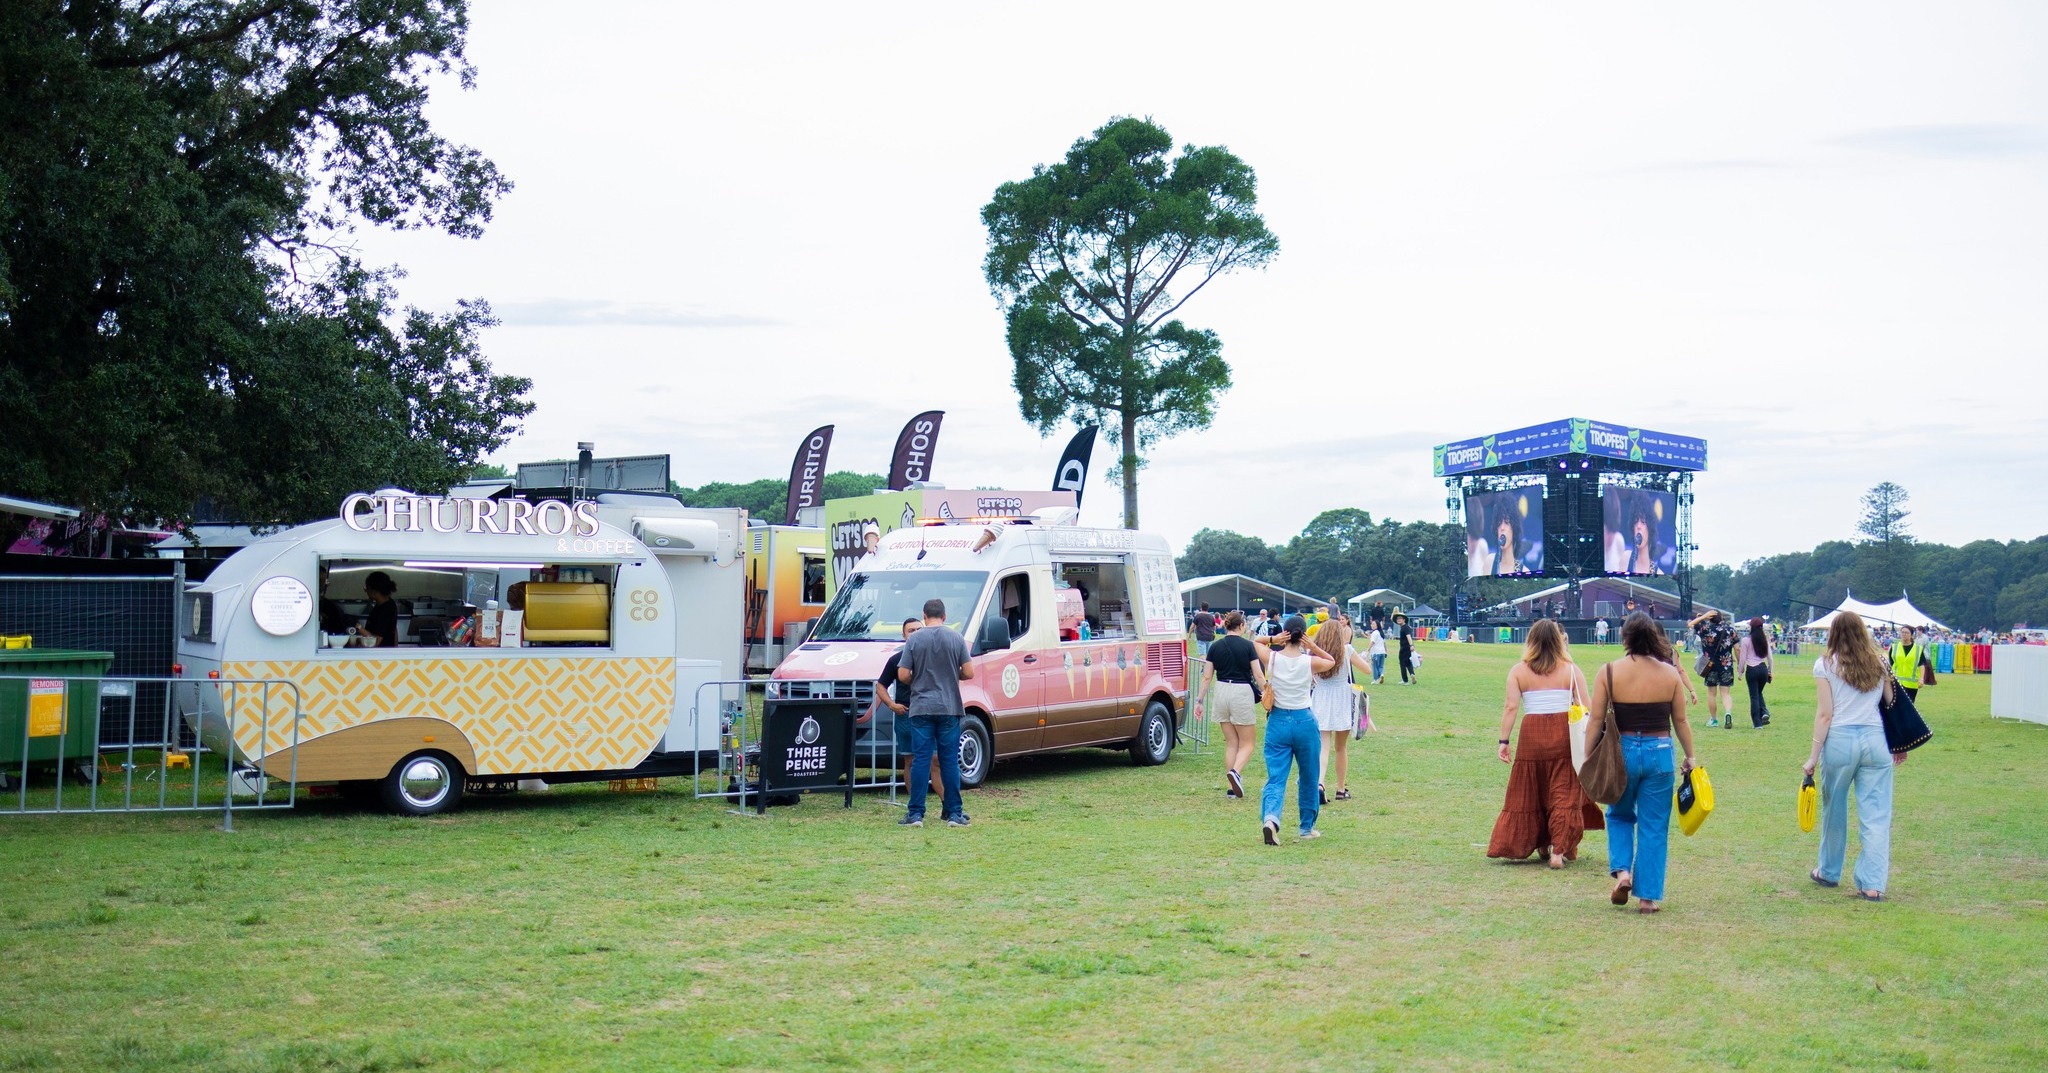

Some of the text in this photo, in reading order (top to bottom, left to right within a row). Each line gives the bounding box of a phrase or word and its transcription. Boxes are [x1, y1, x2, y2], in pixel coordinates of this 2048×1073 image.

[1590, 429, 1628, 450] TROPFEST
[1447, 446, 1483, 466] TROPFEST
[979, 498, 1021, 508] LET'S DO
[341, 492, 600, 537] CHURROS
[832, 523, 861, 549] LET'S
[557, 538, 635, 554] & COFFEE
[889, 541, 926, 550] CAUTION
[630, 590, 658, 604] CO
[630, 607, 658, 621] CO
[1004, 669, 1017, 680] CO
[31, 680, 64, 688] REMONDIS
[1005, 681, 1017, 693] CO
[786, 746, 827, 758] THREE
[785, 758, 826, 771] PENCE
